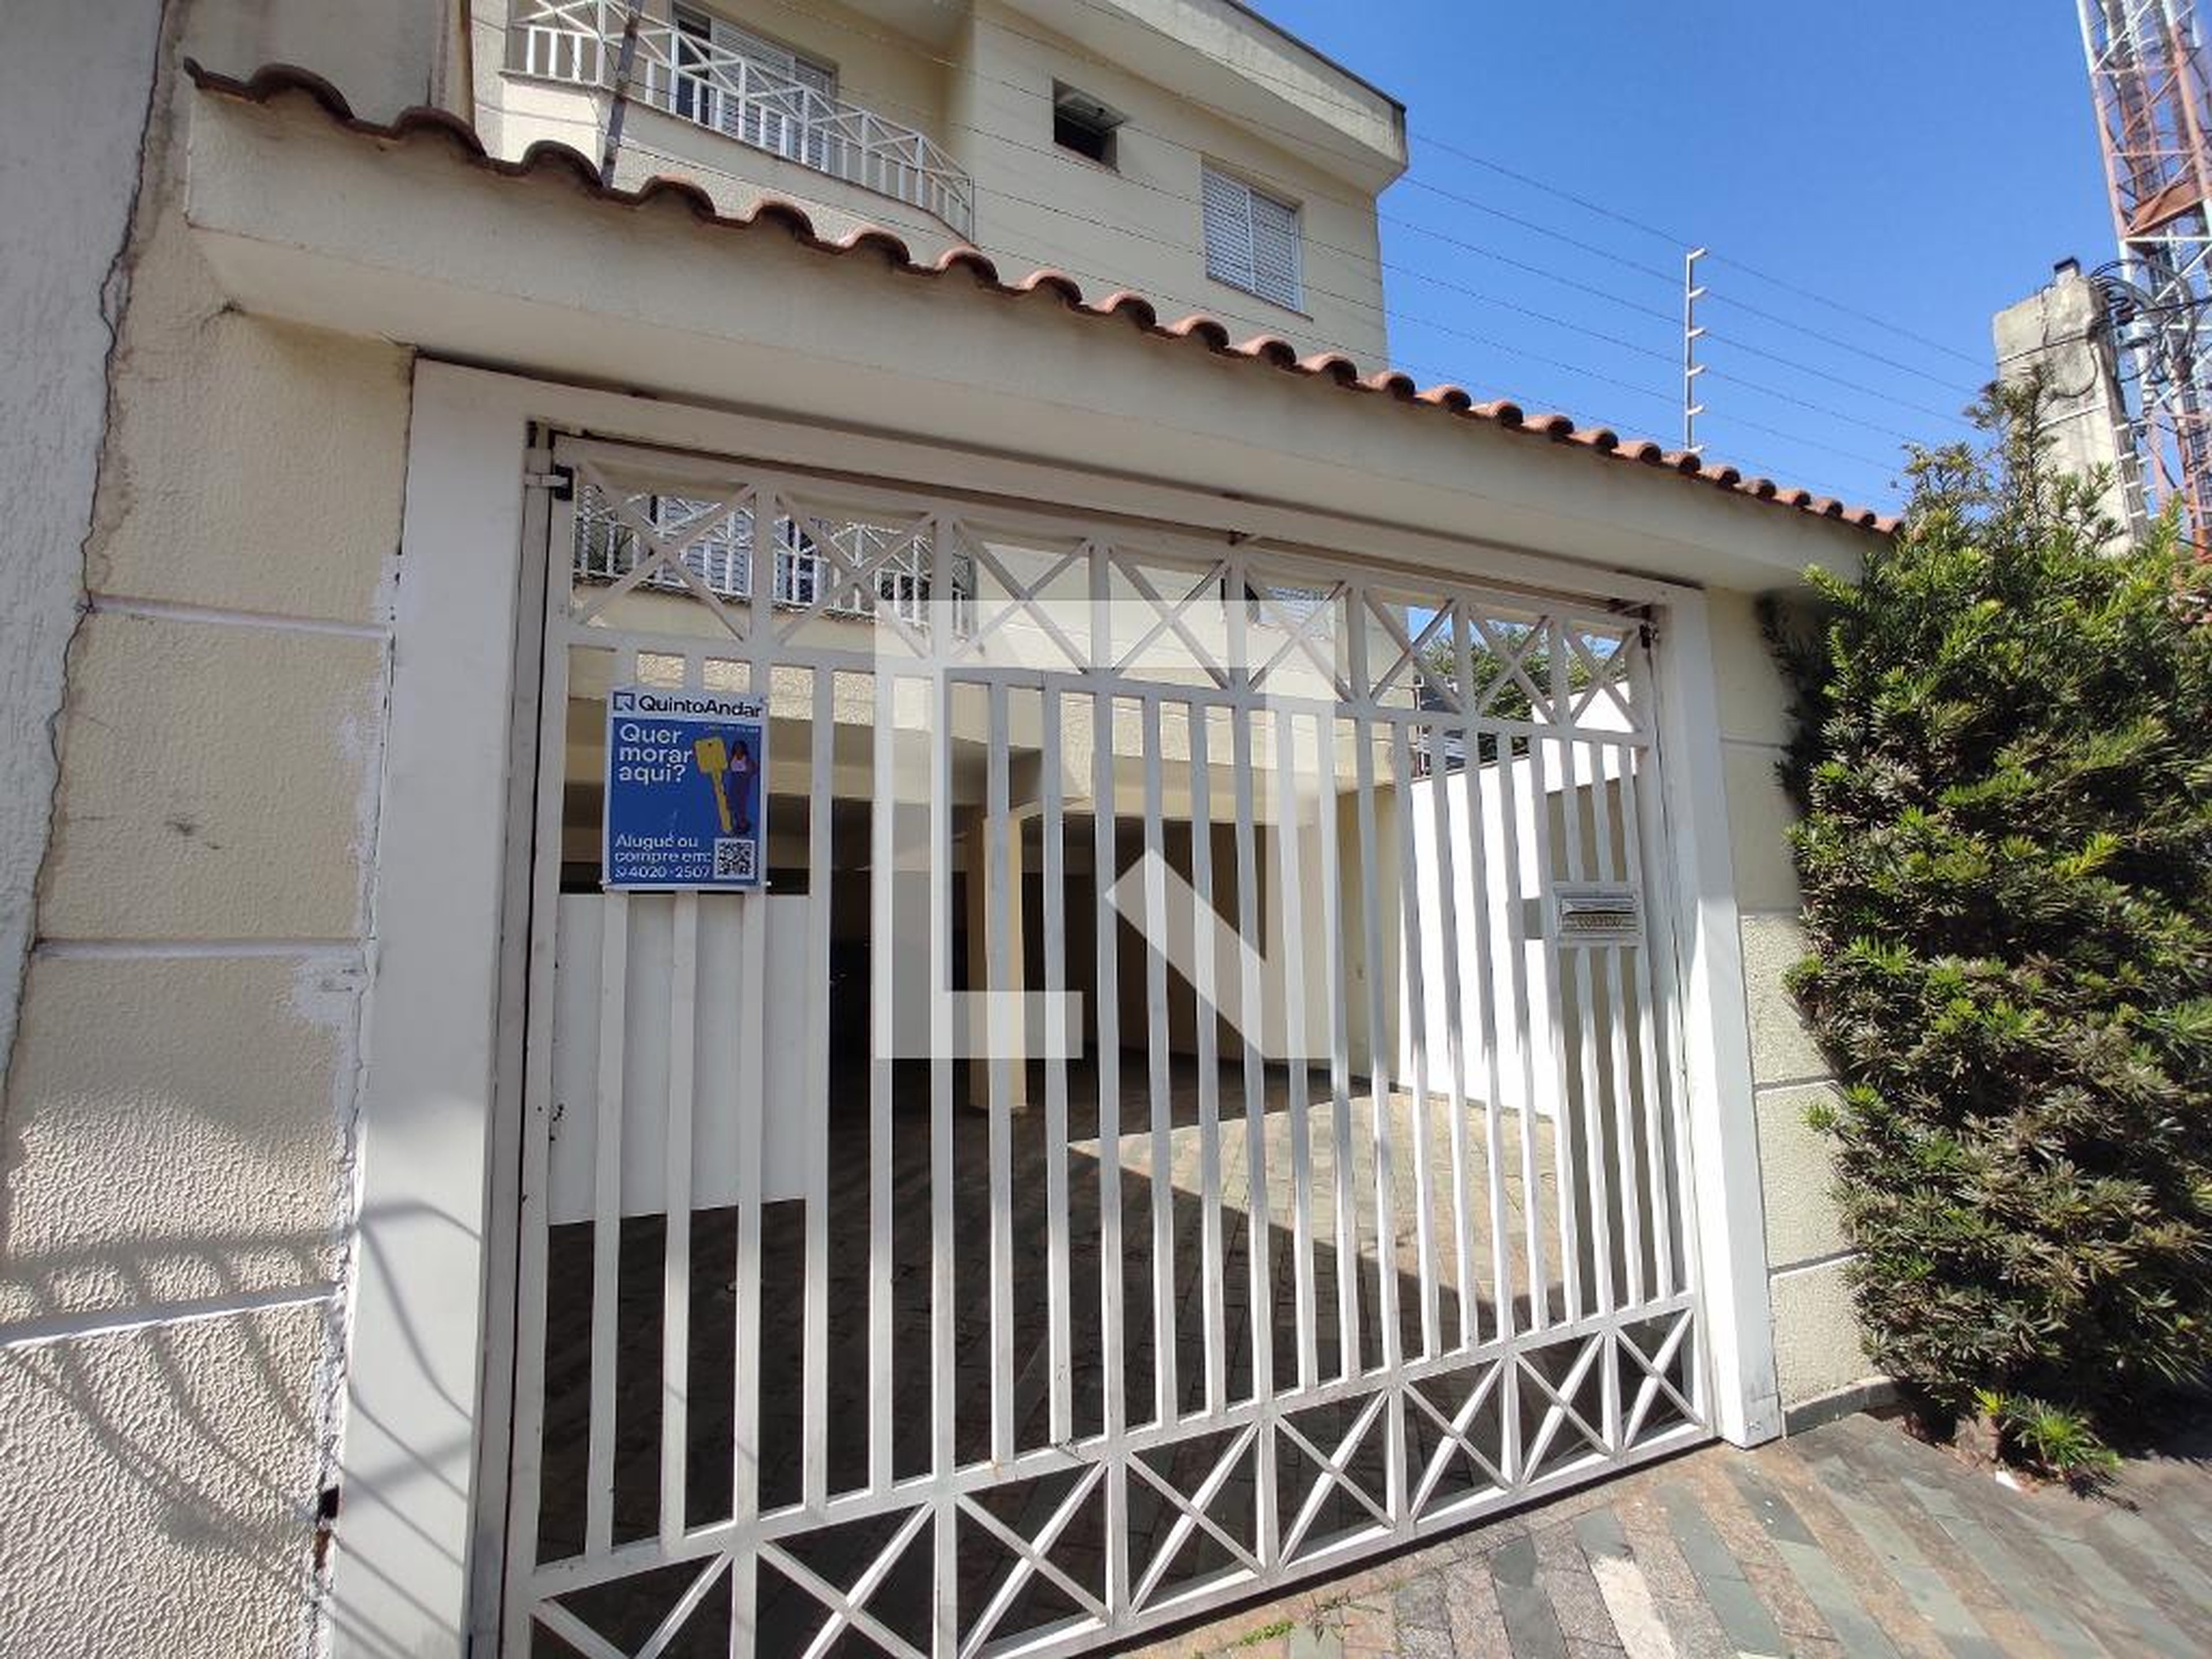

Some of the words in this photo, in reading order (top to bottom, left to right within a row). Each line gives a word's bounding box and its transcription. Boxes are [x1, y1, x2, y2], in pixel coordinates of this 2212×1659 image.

[639, 695, 762, 718] QuintoAndar
[620, 723, 681, 744] Quer
[619, 747, 692, 763] morar
[618, 764, 685, 785] aqui?
[677, 836, 698, 847] ou
[615, 851, 679, 863] compre
[681, 852, 712, 862] em:
